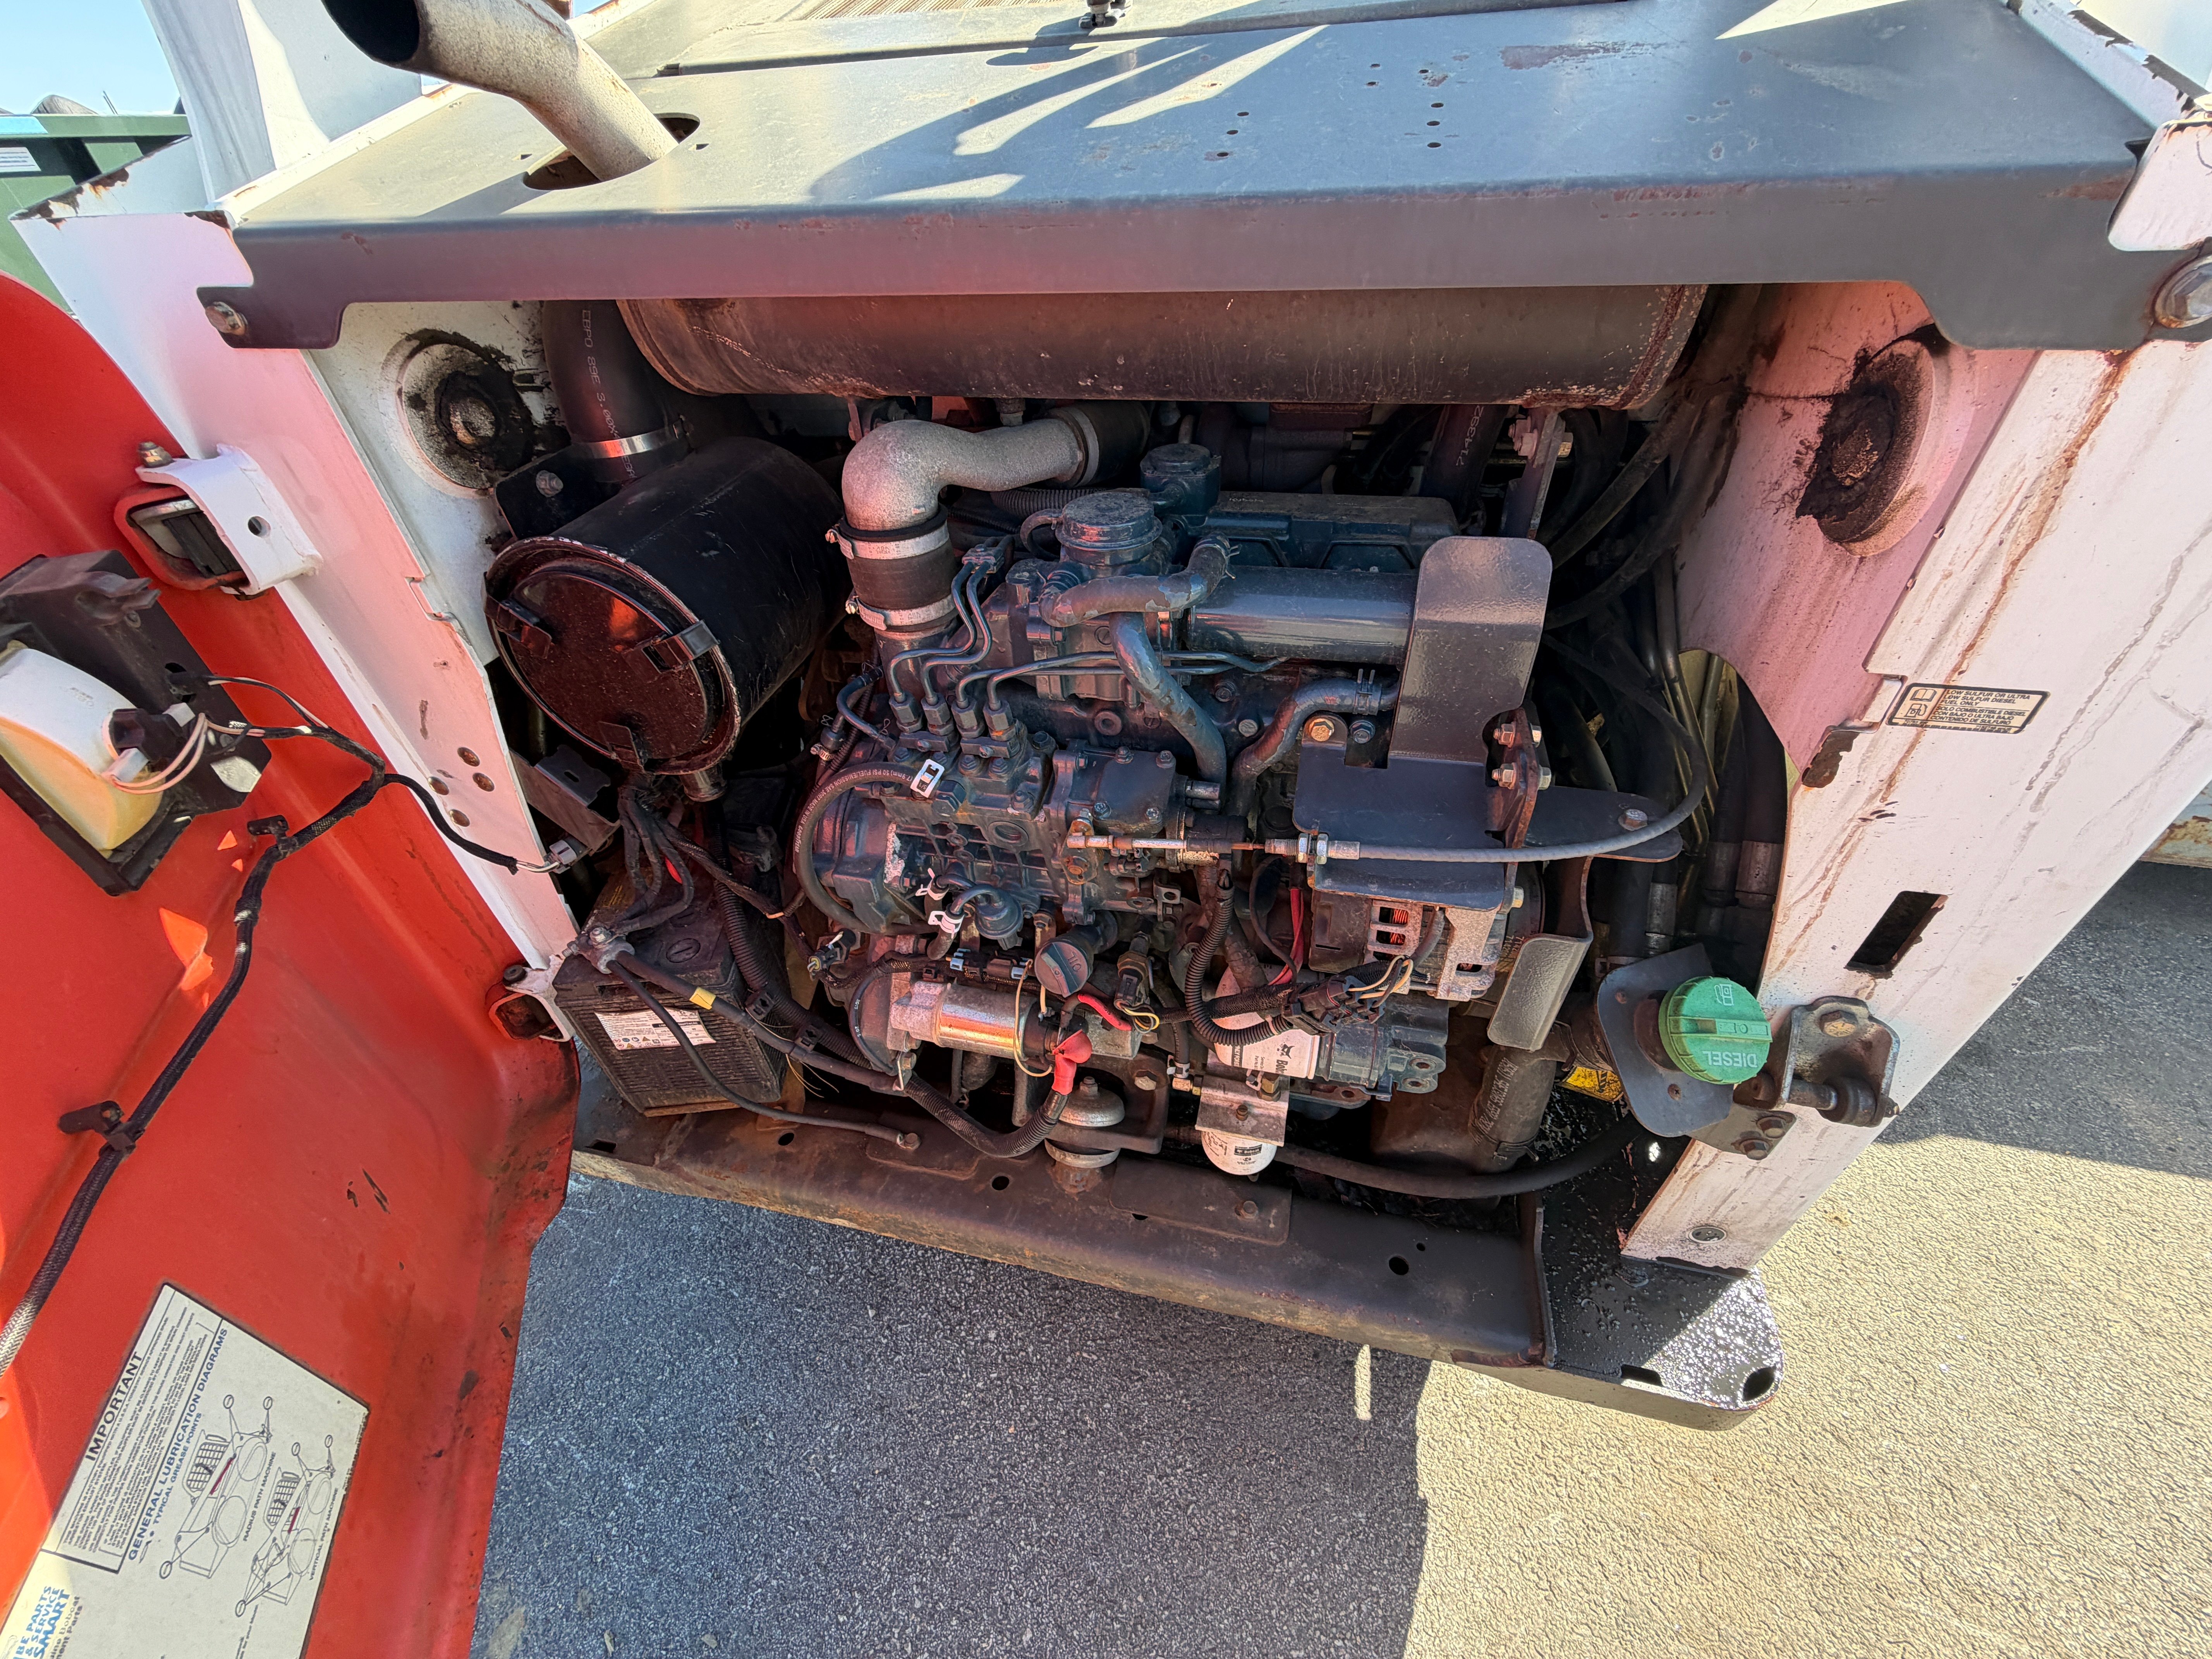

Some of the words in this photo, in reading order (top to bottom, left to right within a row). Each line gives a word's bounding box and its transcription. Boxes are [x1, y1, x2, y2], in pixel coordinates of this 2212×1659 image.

[807, 799, 819, 811] MADE
[826, 781, 835, 794] SAE
[833, 769, 871, 787] FUEL/EMISSION
[1068, 951, 1081, 972] OIL
[1702, 1051, 1758, 1068] DIESEL
[85, 1350, 143, 1462] IMPORTANT
[126, 1486, 163, 1561] GENERAL
[158, 1393, 201, 1485] LUBRICATION
[196, 1327, 228, 1392] DIAGRAMS
[152, 1484, 173, 1526] TYPICAL
[169, 1445, 189, 1484] GREASE
[185, 1411, 202, 1444] POINTS
[242, 1509, 257, 1542] RADIUS
[253, 1487, 264, 1509] PATH
[260, 1451, 276, 1487] MACHINE
[308, 1542, 323, 1581] VERTICAL
[325, 1487, 338, 1521] MACHINE
[16, 1636, 30, 1655] BE
[26, 1586, 52, 1632] PARTS
[25, 1647, 34, 1656] &
[31, 1588, 60, 1643] SERVICE
[33, 1589, 70, 1659] SMART
[58, 1596, 80, 1635] Bobcat
[66, 1606, 83, 1634] Parts
